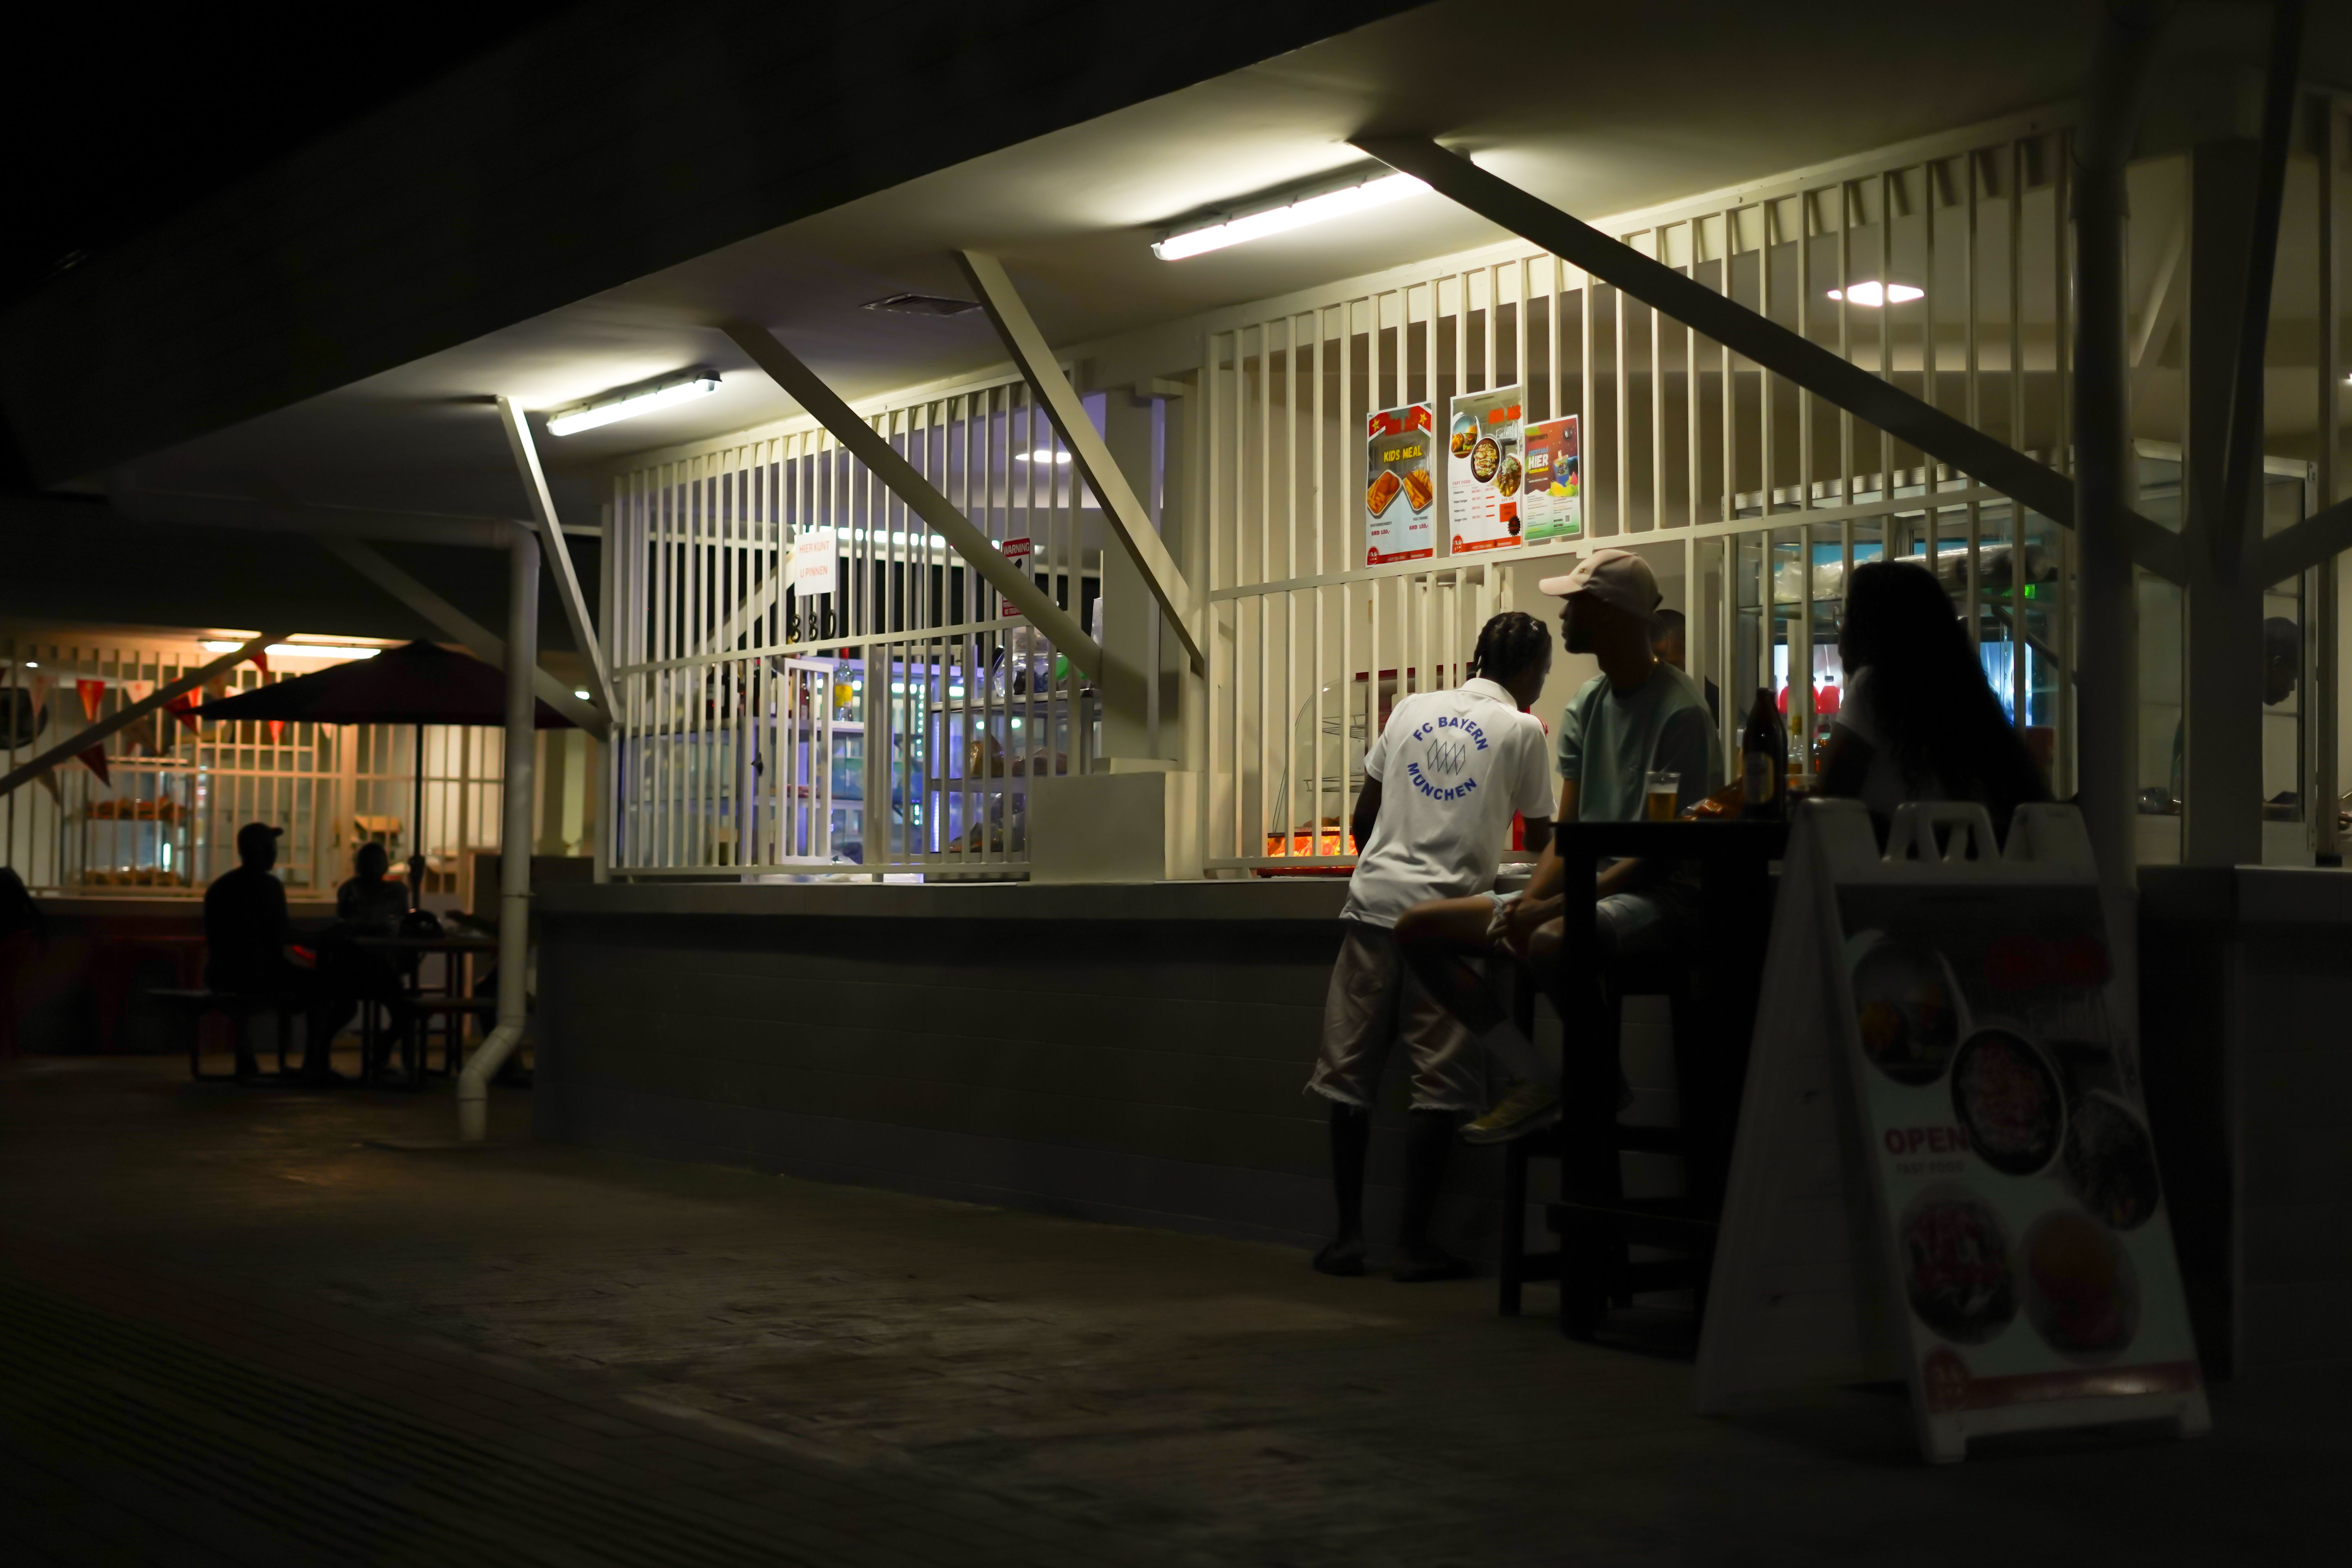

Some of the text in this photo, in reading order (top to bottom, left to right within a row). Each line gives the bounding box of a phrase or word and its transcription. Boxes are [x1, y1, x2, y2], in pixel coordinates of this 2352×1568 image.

[1384, 445, 1422, 463] KIDS MEAL
[1528, 454, 1548, 469] HIER
[799, 541, 830, 553] HIER KUNT
[1003, 542, 1030, 555] WARNING
[800, 565, 828, 578] U PINNEN
[1412, 716, 1488, 751] FC BAYERN
[1407, 762, 1477, 801] MÜNCHEN
[1885, 1126, 1970, 1155] OPEN
